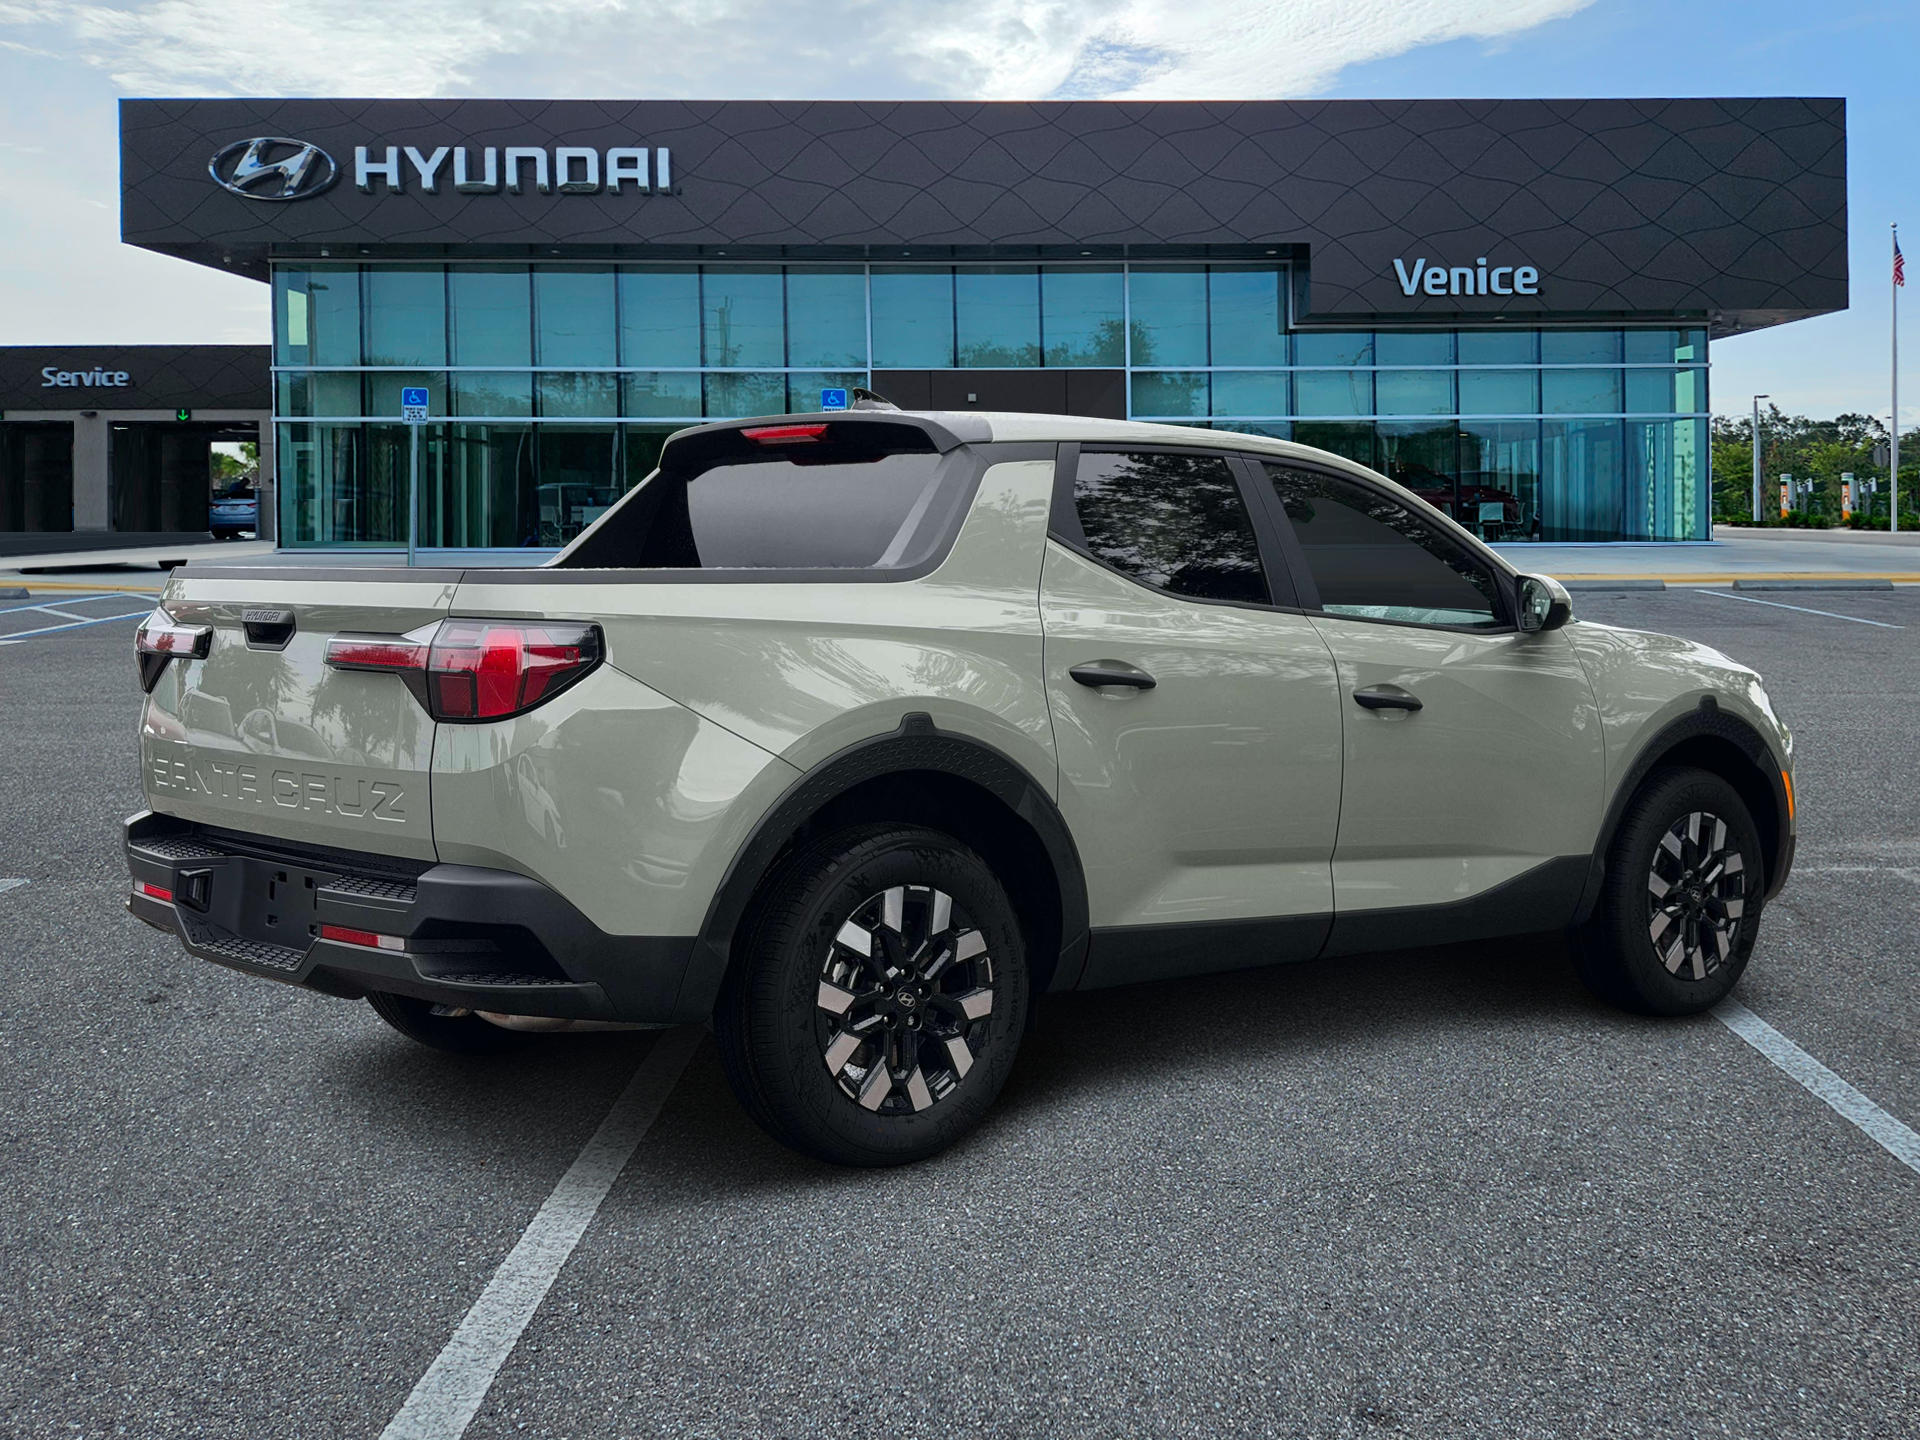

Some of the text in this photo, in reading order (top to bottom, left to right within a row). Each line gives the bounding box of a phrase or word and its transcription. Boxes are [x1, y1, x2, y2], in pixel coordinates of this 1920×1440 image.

[355, 146, 671, 194] HYUNDAI
[1393, 257, 1539, 296] Venice
[41, 366, 130, 387] Service
[244, 610, 281, 622] HYUNDAI
[153, 752, 406, 823] SANTA CRUZ
